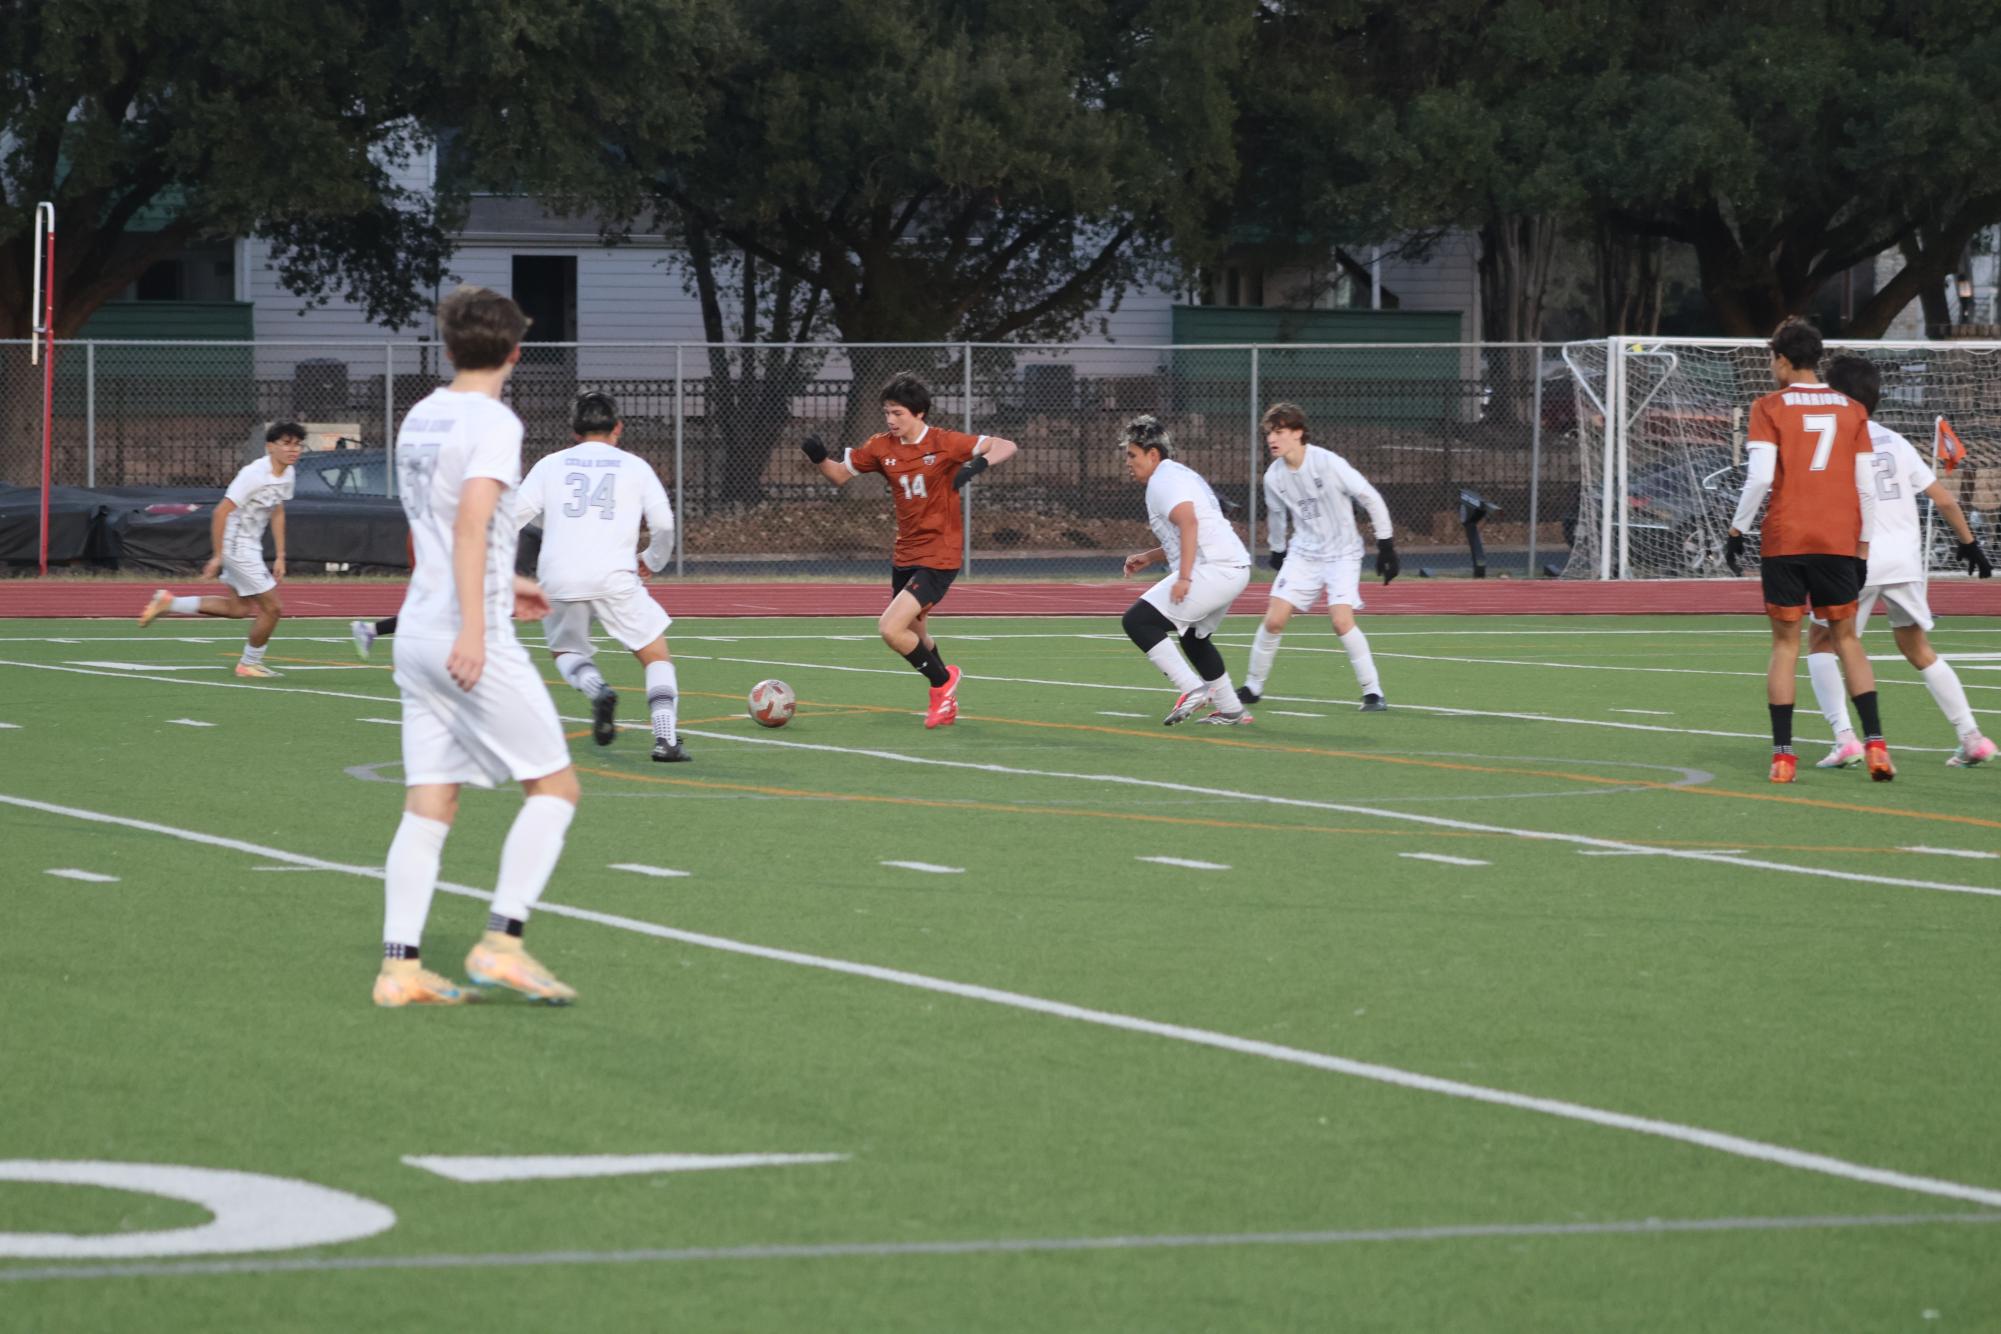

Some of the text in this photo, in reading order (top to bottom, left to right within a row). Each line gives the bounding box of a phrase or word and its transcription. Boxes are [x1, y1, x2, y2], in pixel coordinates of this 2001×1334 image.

[1802, 414, 1837, 471] 7
[563, 472, 616, 520] 34
[898, 473, 928, 500] 14
